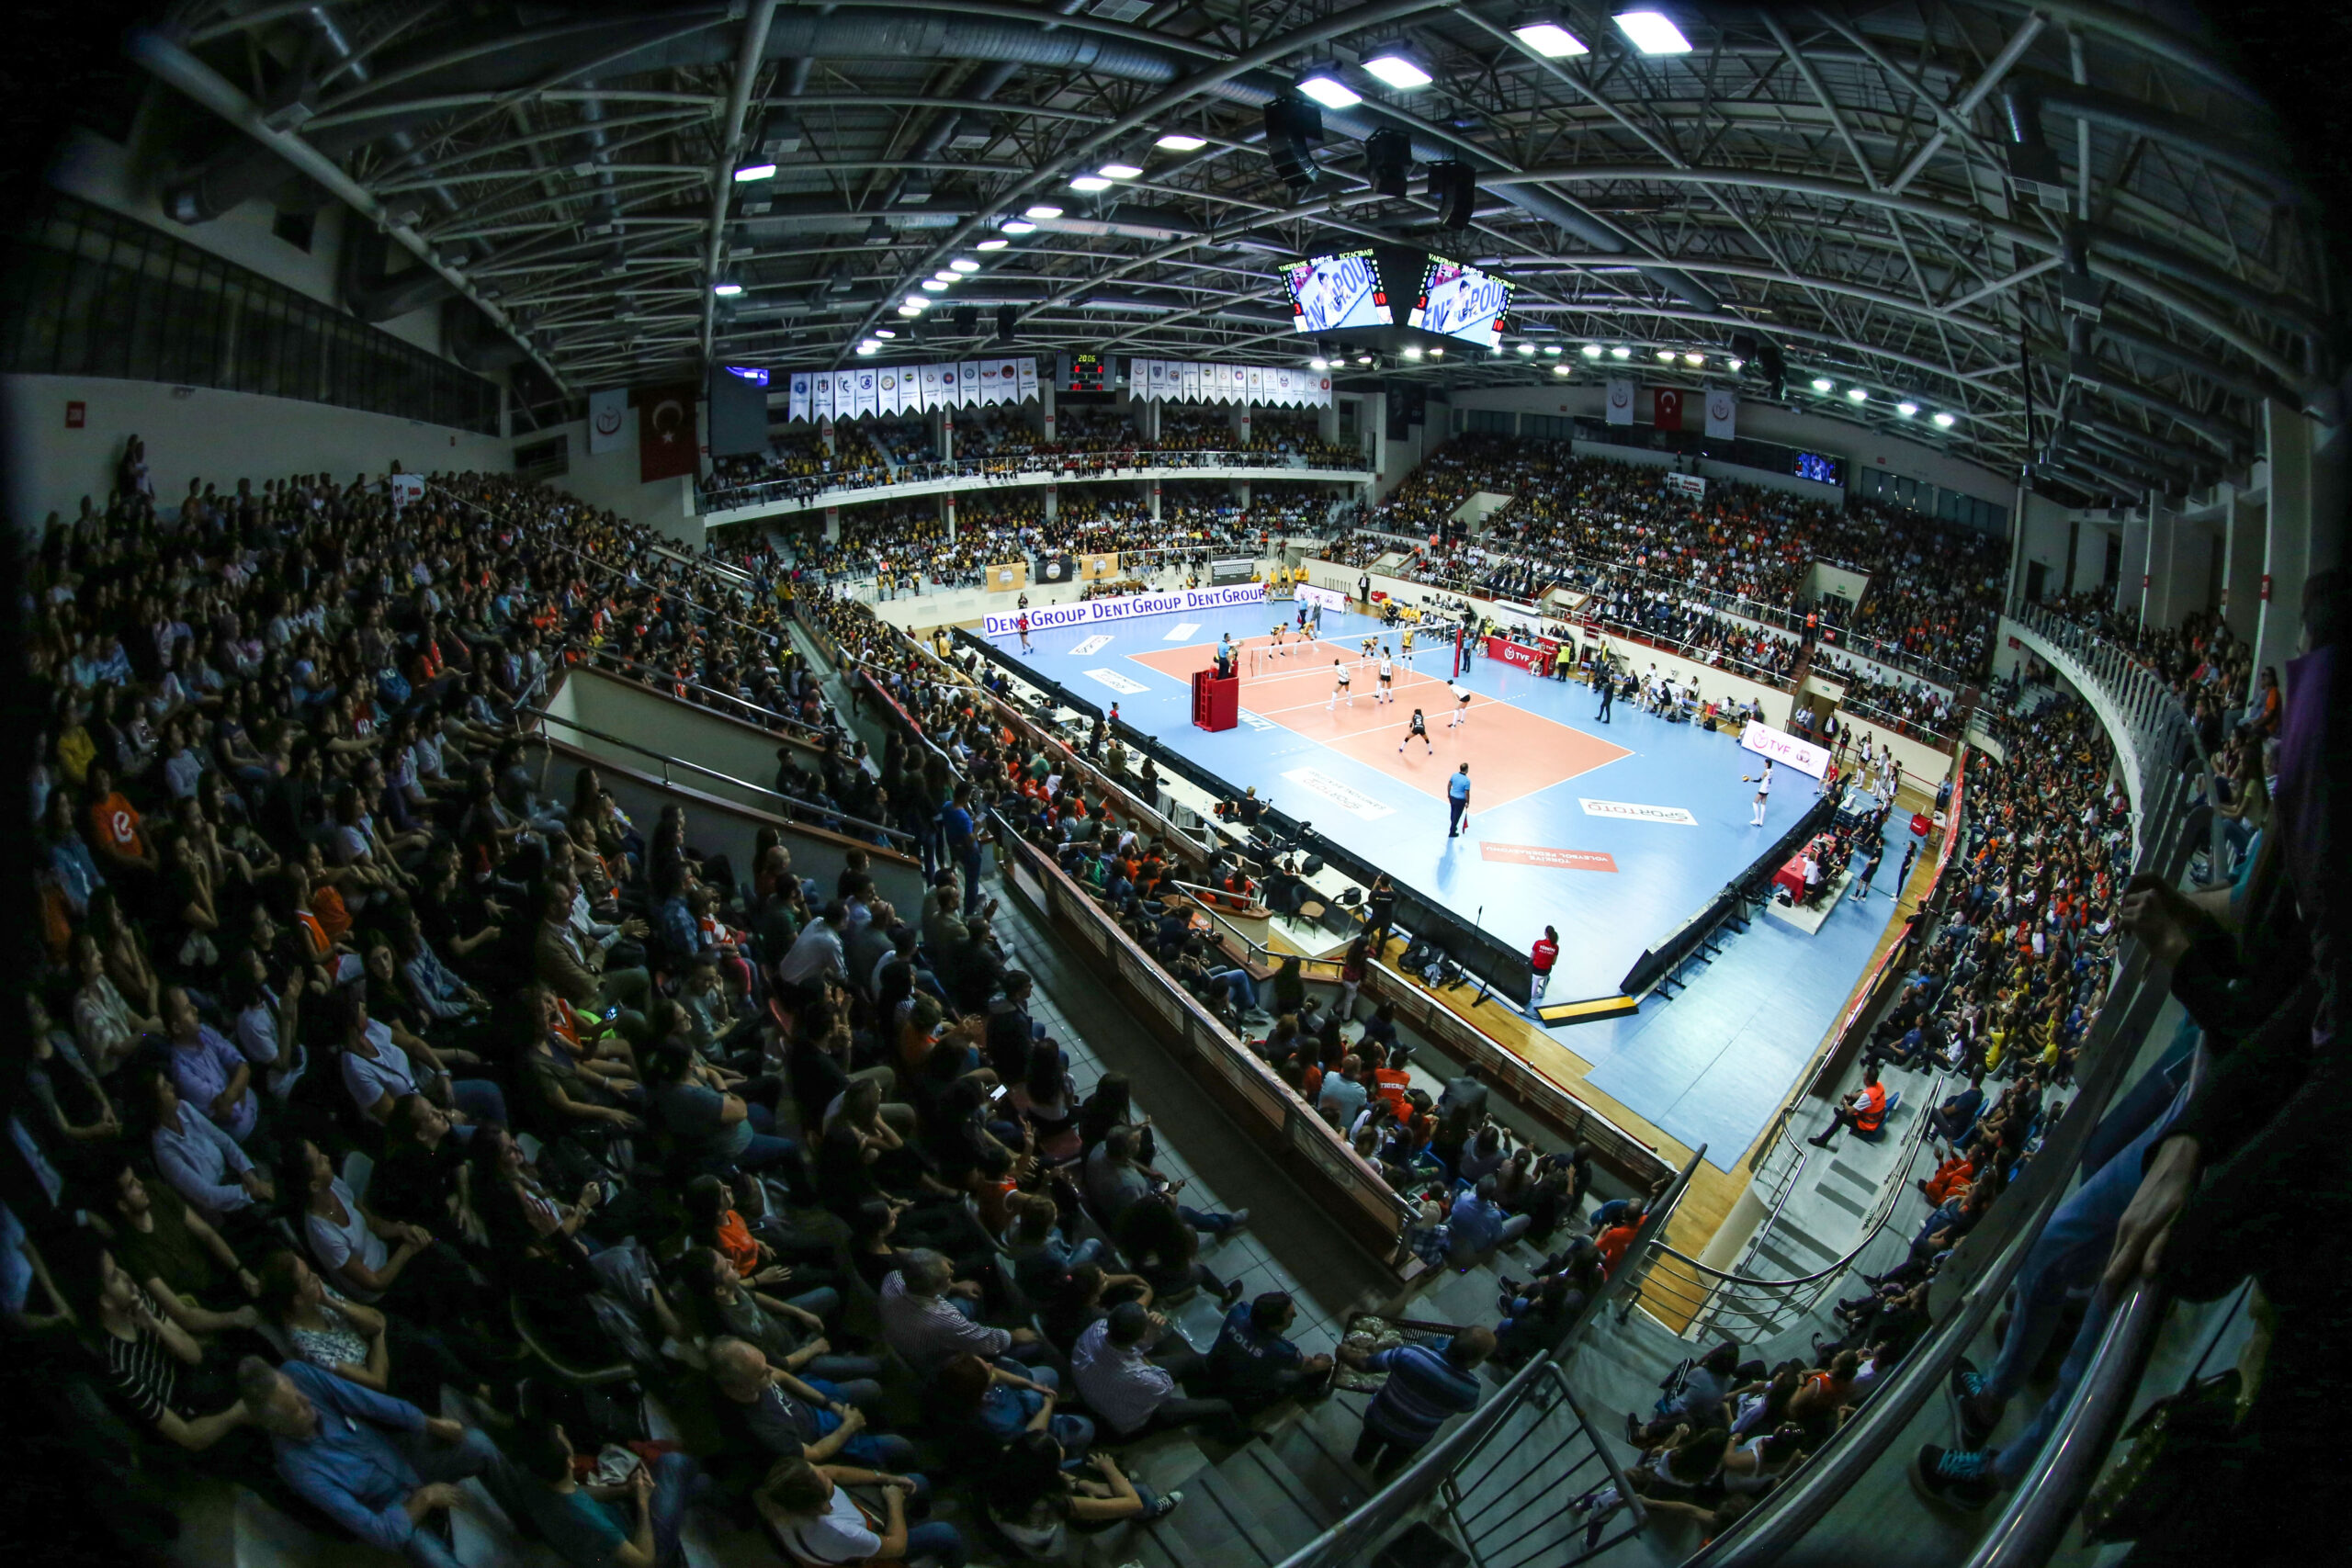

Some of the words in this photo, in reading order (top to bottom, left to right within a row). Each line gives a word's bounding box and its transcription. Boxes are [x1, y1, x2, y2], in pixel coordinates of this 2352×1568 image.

[1373, 292, 1387, 304] 10
[1418, 297, 1426, 309] 3
[1294, 303, 1302, 314] 3
[1493, 319, 1504, 331] 10
[1514, 651, 1531, 662] TVF
[1770, 739, 1792, 755] TVF
